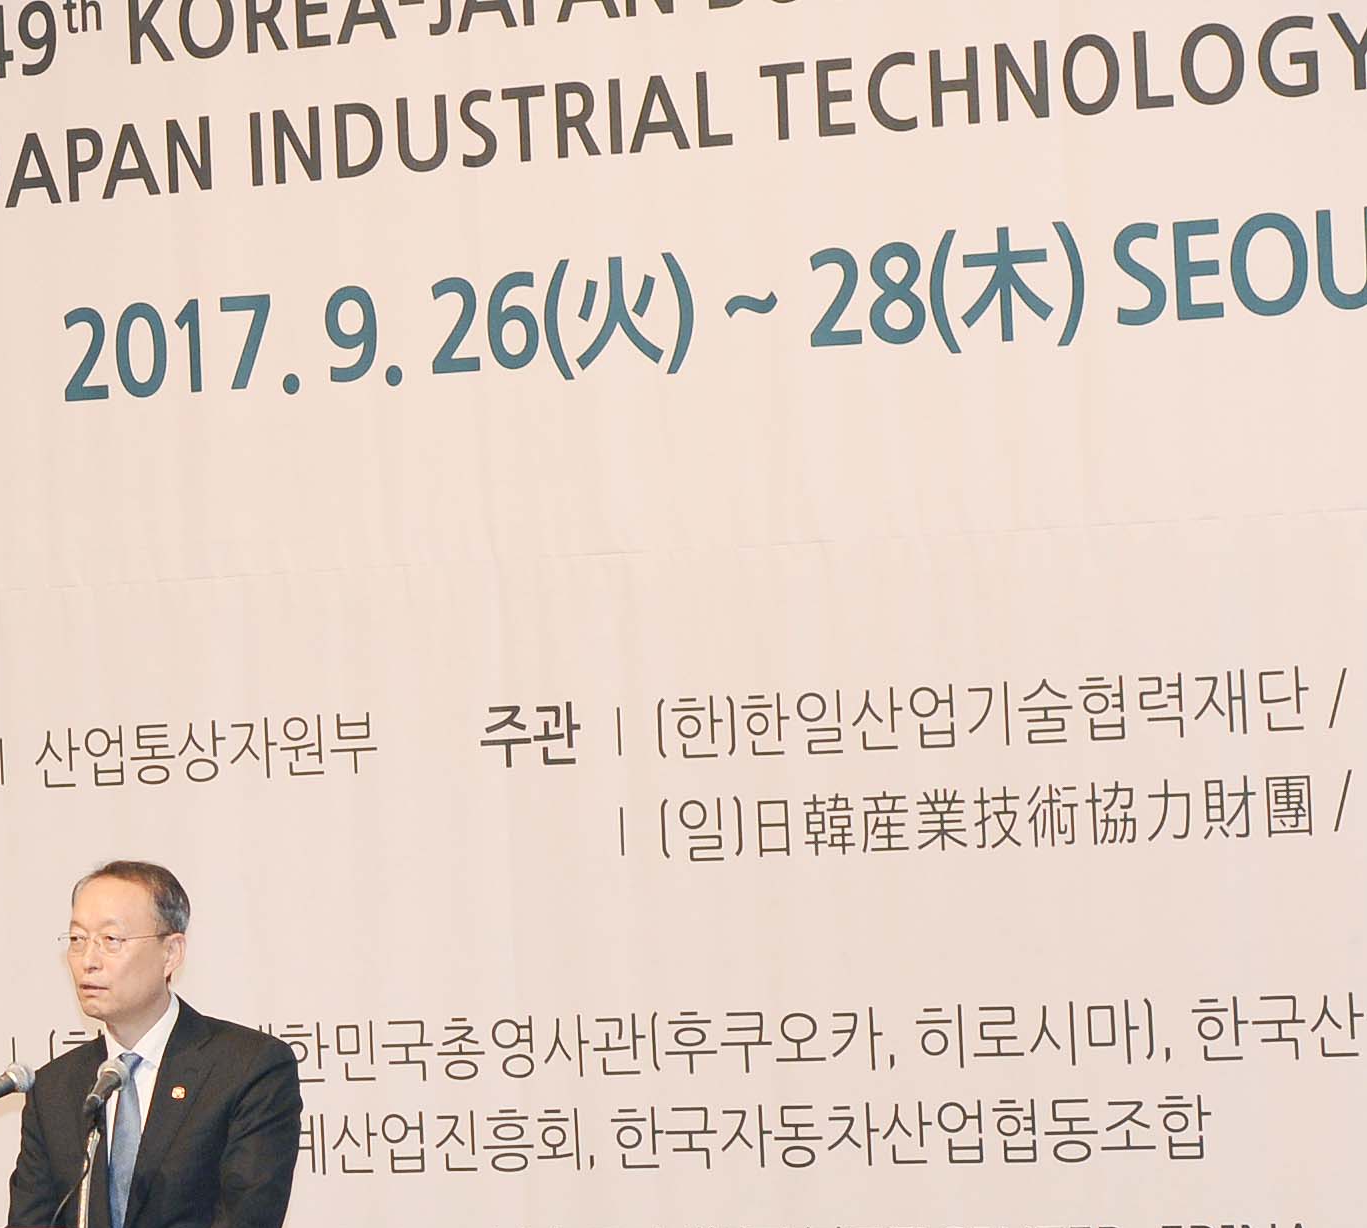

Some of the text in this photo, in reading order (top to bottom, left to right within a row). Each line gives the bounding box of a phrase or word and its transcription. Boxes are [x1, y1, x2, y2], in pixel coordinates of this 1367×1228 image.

[249, 70, 734, 187] INDUSTRIAL
[758, 12, 1367, 141] TECHNOLOGY
[63, 293, 301, 403] 2017.
[324, 285, 403, 387] 9.
[431, 251, 695, 381] 26(火)
[809, 220, 1085, 355] 28(木)
[34, 712, 378, 789] 산업통상자원부
[480, 700, 582, 769] 주관
[656, 666, 1309, 759] (한)한일산업기술협력재단
[660, 774, 1313, 862] (일)日韓産業技術協力財團
[258, 1005, 896, 1082] 한민국총영사관(후쿠오카,
[915, 998, 1171, 1069] 히로시마),
[1191, 992, 1365, 1062] 한국산
[611, 1094, 1211, 1170] 한국자동차산업협동조합
